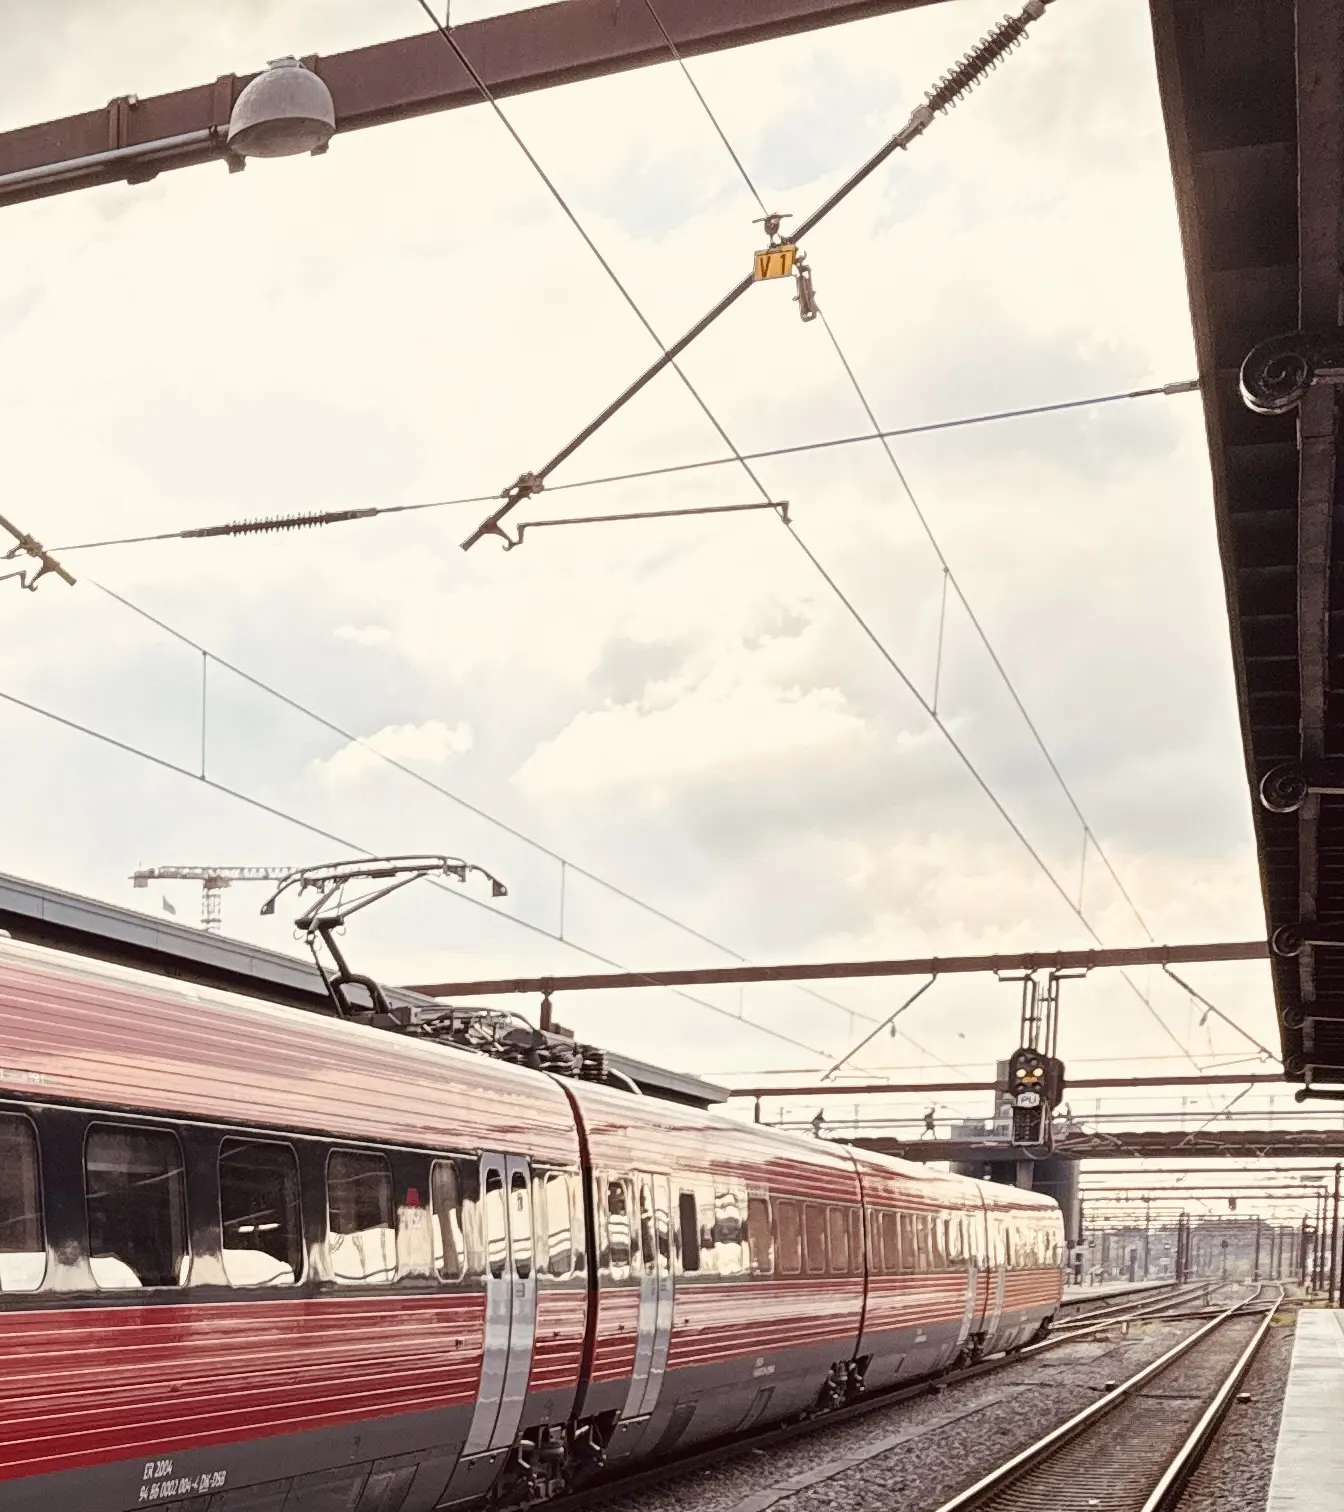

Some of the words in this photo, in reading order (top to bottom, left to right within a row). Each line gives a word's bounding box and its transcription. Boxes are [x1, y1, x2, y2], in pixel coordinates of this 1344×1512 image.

[143, 1462, 154, 1480] ER
[154, 1460, 172, 1477] 2004
[138, 1485, 149, 1501] 94
